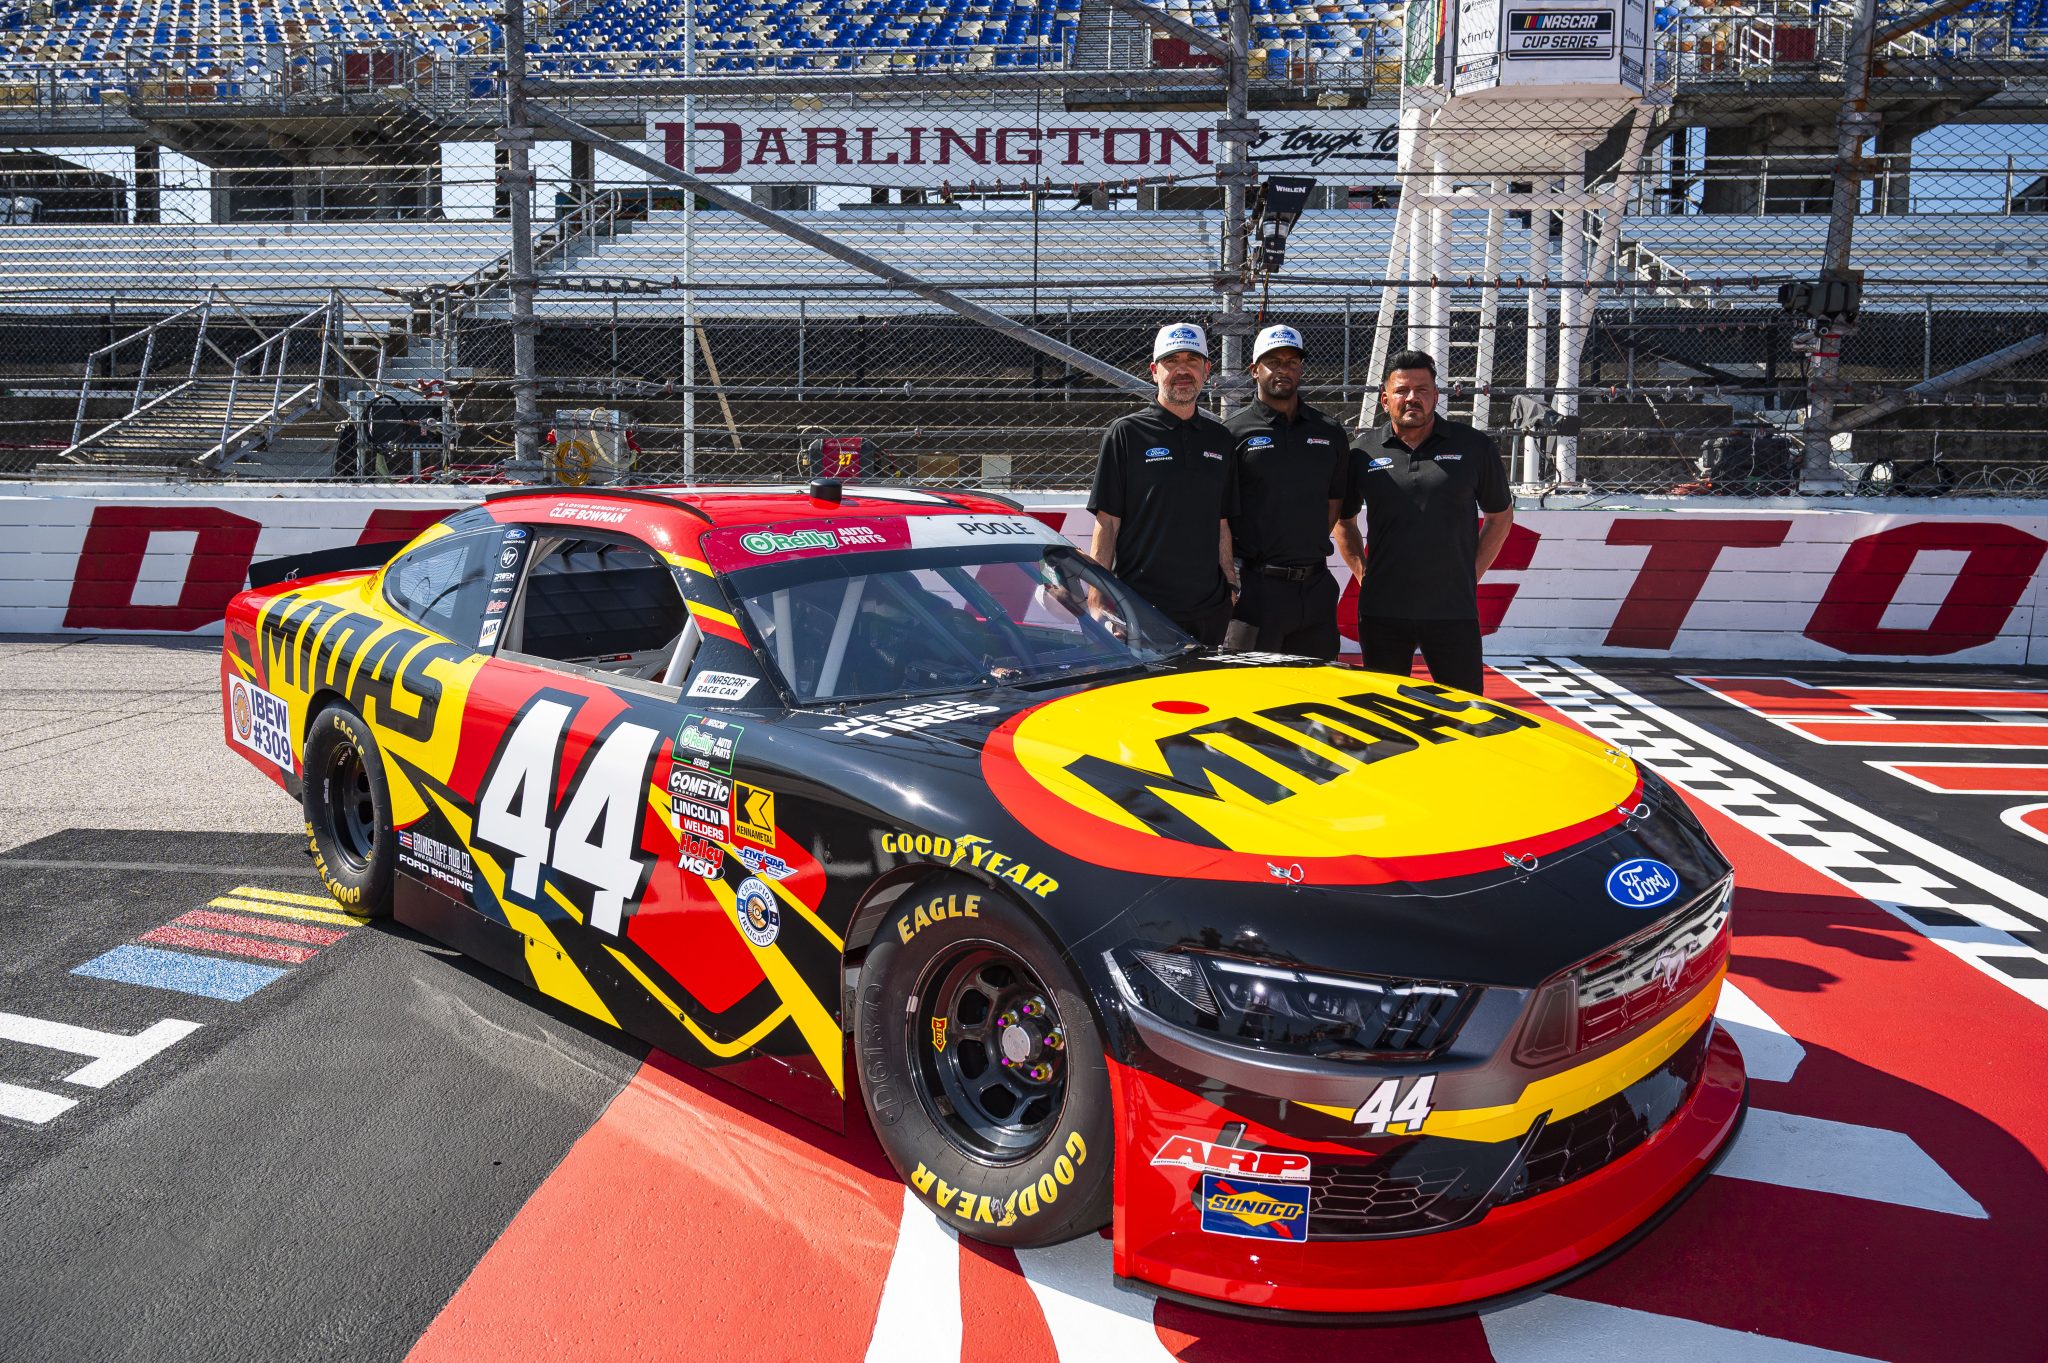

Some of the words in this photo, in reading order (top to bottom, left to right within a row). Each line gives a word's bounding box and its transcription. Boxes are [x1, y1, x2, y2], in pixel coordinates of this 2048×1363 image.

[1541, 15, 1599, 29] NASCAR
[1461, 28, 1495, 46] xfinity
[1522, 36, 1550, 48] CUP
[1551, 35, 1599, 48] SERIES
[655, 122, 1215, 175] DARLINGTON
[1281, 124, 1365, 167] tough
[1368, 123, 1399, 152] to
[1275, 184, 1307, 194] WHELEN
[1172, 329, 1193, 339] Ford
[1273, 330, 1296, 340] Ford
[1149, 448, 1166, 457] Ford
[1251, 437, 1268, 446] Ford
[838, 453, 852, 465] 27
[549, 507, 578, 519] CLIFF
[576, 509, 628, 524] BOWMAN
[744, 530, 837, 553] O'Reilly
[838, 526, 874, 536] AUTO
[840, 534, 886, 545] PARTS
[957, 522, 1035, 536] POOLE
[482, 621, 499, 637] WIX
[261, 593, 475, 743] MIDAS
[711, 674, 747, 688] NASCAR
[696, 685, 719, 694] RACE
[719, 687, 738, 696] CAR
[250, 688, 287, 733] IBEW
[820, 714, 889, 731] WE
[885, 700, 970, 717] SELL
[843, 703, 1001, 739] TIRES
[253, 720, 291, 766] #309
[333, 715, 365, 758] EAGLE
[716, 737, 732, 749] AUTO
[692, 757, 710, 769] SERIES
[712, 746, 731, 760] PARTS
[1062, 684, 1542, 851] MIDAS
[670, 772, 729, 802] COMETIC
[674, 787, 697, 798] GASKET
[476, 698, 660, 937] 44
[673, 798, 719, 824] LINCOLN
[683, 818, 724, 841] WELDERS
[736, 824, 774, 846] KENNAMETAL
[413, 831, 447, 863] GRINDSTAFF
[679, 832, 724, 869] Holley
[744, 848, 763, 861] FIVE
[765, 855, 785, 871] STAR
[399, 853, 430, 874] FORD
[430, 866, 474, 894] RACING
[678, 854, 718, 879] MSD
[881, 833, 1059, 899] GOODYEAR
[741, 881, 774, 907] CHAMPION
[1617, 864, 1672, 902] Ford
[740, 916, 775, 944] IRRIGATION
[897, 894, 981, 945] EAGLE
[935, 1021, 944, 1047] AERO
[1353, 1074, 1437, 1134] 44
[1154, 1137, 1310, 1176] ARP
[910, 1131, 1087, 1226] GOODYEAR
[1211, 1196, 1302, 1220] SUNOCO
